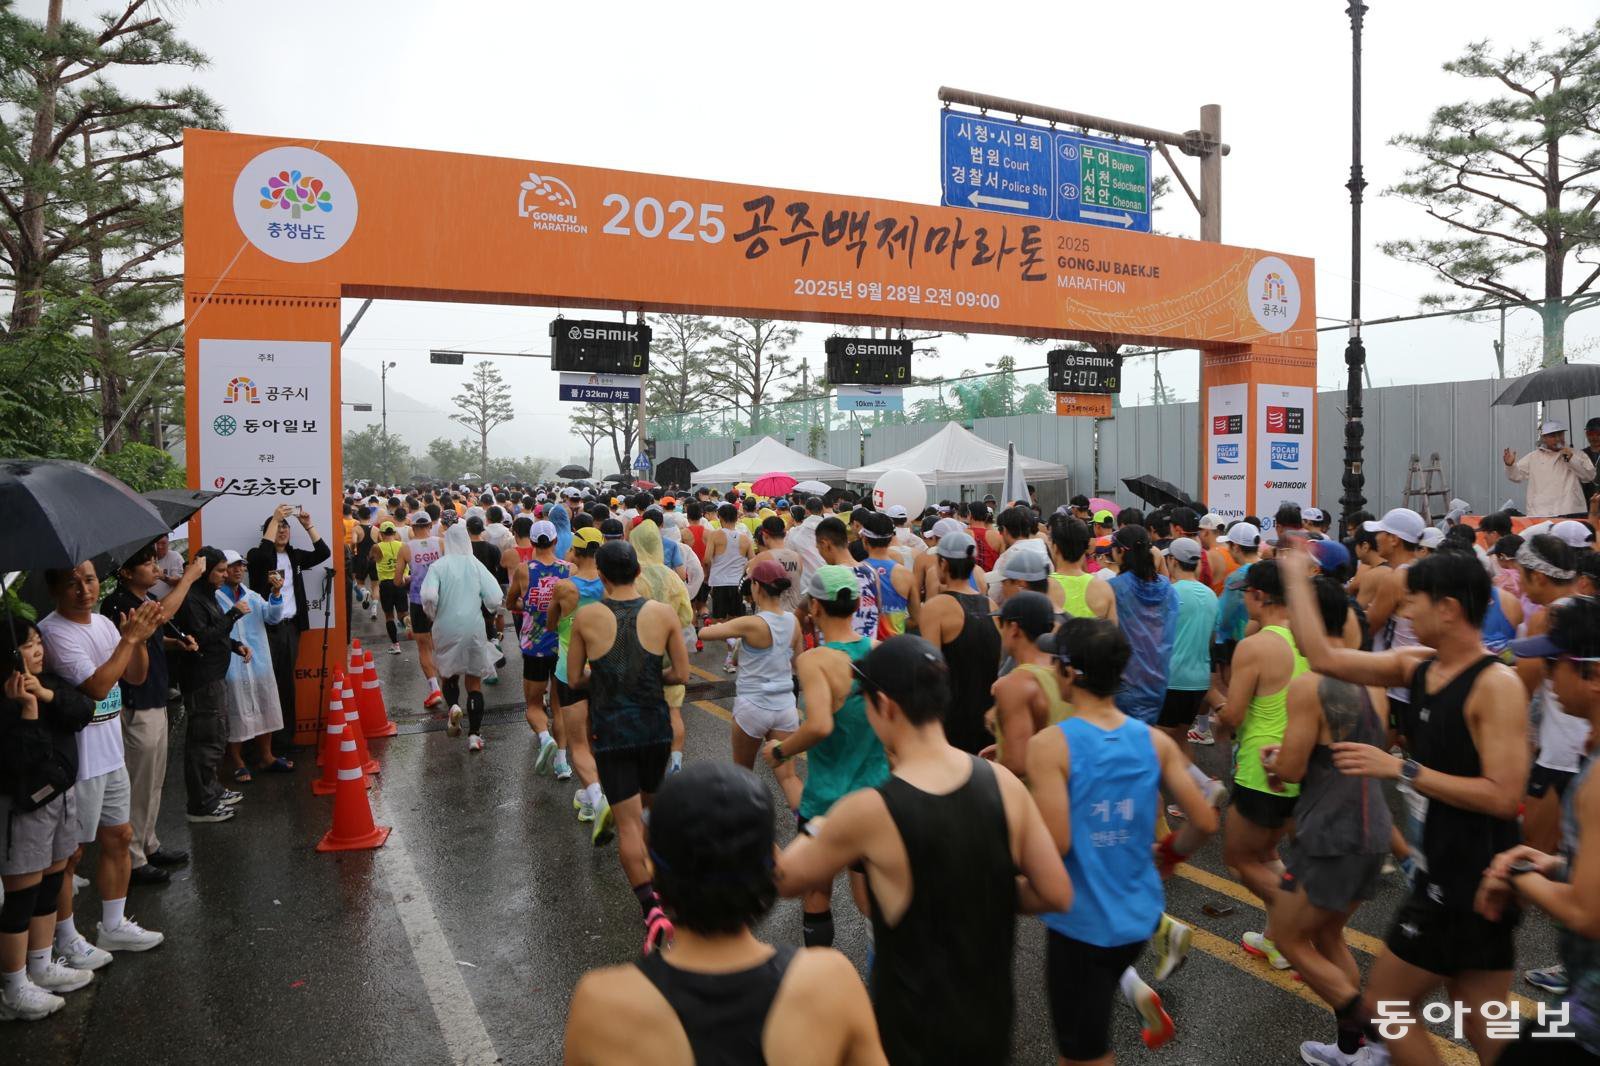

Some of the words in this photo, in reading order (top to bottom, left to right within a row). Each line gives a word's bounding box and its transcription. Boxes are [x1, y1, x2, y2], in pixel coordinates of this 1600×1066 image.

[970, 146, 1000, 167] 법원
[1003, 157, 1029, 171] Court
[1062, 147, 1075, 158] 40
[1082, 148, 1110, 168] 부여
[1112, 161, 1134, 174] Buyeo
[952, 166, 998, 189] 경찰서
[1002, 179, 1030, 194] Police
[1032, 184, 1047, 196] Stn
[1083, 170, 1110, 188] 서천
[1112, 179, 1146, 193] Seocheon
[1063, 186, 1076, 196] 23
[1083, 186, 1110, 205] 천안
[1112, 198, 1142, 210] Cheonan
[533, 212, 577, 223] GONGJU
[267, 222, 326, 239] 충청남도
[533, 222, 588, 234] MARATHON
[602, 193, 726, 243] 2025
[733, 194, 1048, 282] 공주백제마라톤
[1057, 235, 1090, 252] 2025
[1057, 256, 1112, 273] GONGJU
[1114, 260, 1160, 279] BAEKJE
[1057, 275, 1125, 294] MARATHON
[794, 278, 853, 299] 2025년
[857, 282, 882, 301] 9월
[887, 284, 921, 304] 28일
[925, 288, 952, 306] 오전
[956, 291, 1000, 309] 09:00
[1262, 303, 1287, 318] 공주시
[583, 328, 639, 341] SAMIK
[857, 345, 902, 355] SAMIK
[257, 353, 275, 362] 주최
[1076, 356, 1114, 367] SAMIK
[265, 387, 308, 401] 공주시
[585, 390, 609, 398] 32km
[615, 390, 629, 399] 하프
[243, 419, 318, 433] 동아일보
[258, 454, 275, 463] 주관
[222, 477, 320, 496] 스포츠동아
[1218, 509, 1245, 517] HANJIN
